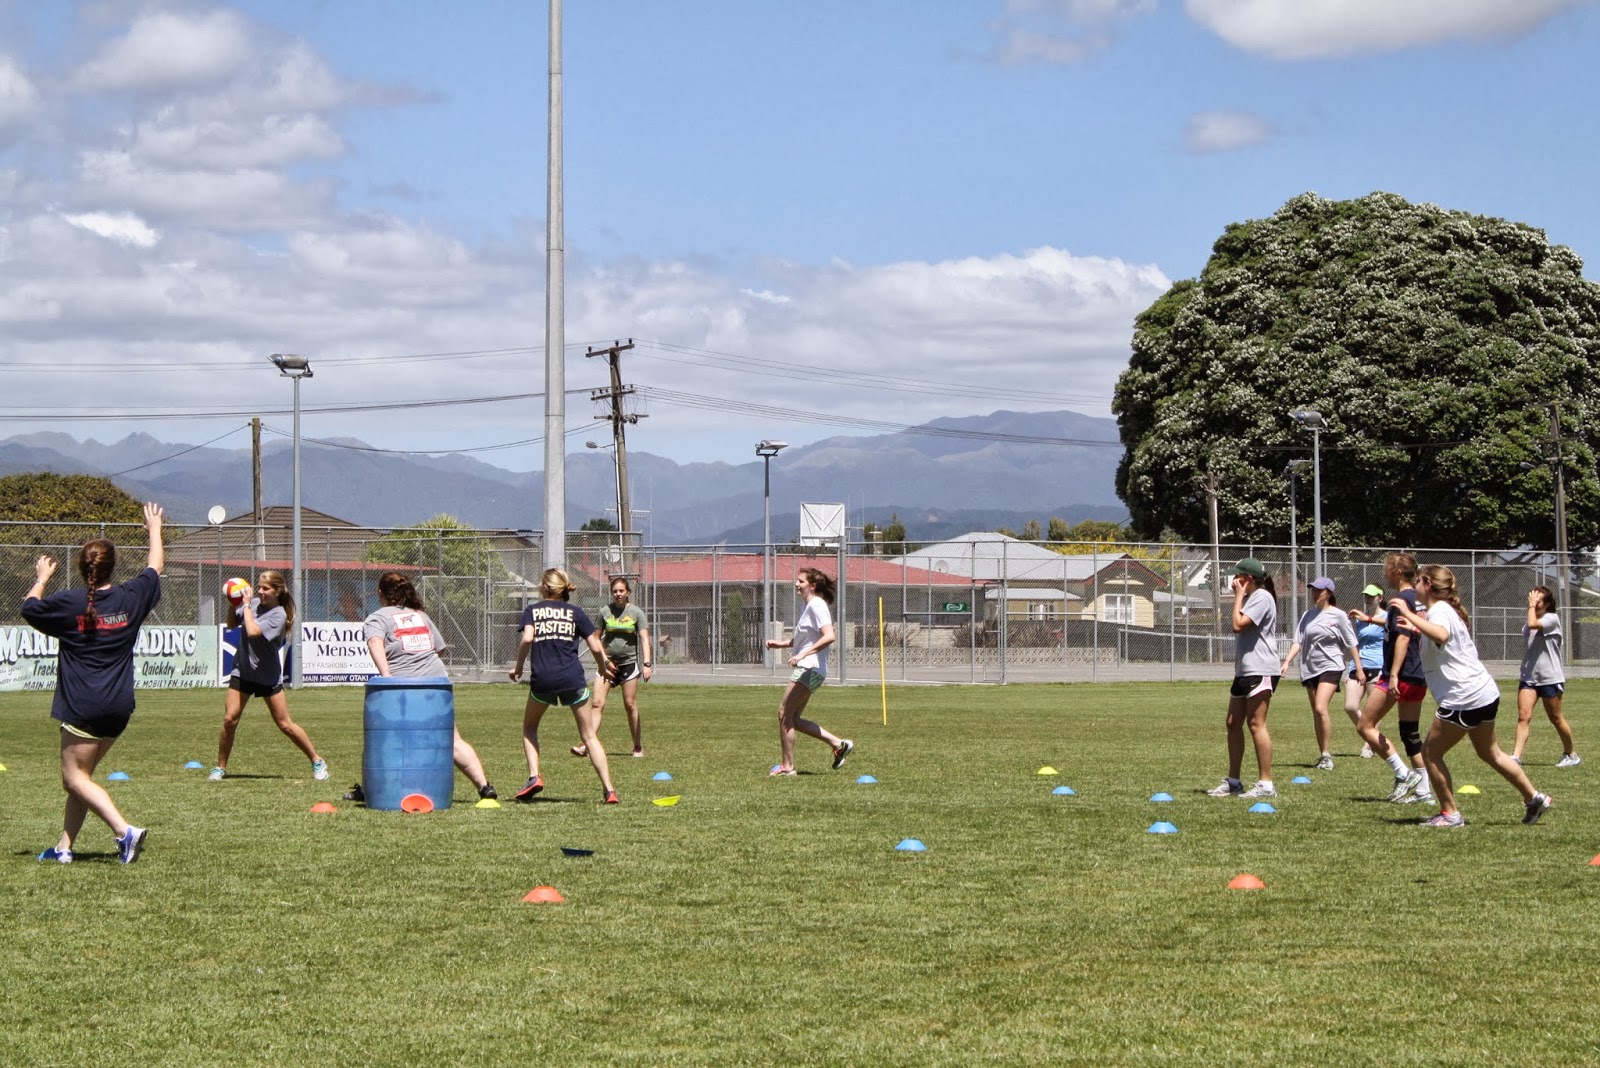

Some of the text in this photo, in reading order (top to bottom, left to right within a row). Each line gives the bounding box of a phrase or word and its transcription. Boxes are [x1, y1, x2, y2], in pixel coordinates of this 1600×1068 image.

[104, 613, 128, 625] SHOW
[532, 607, 573, 621] PADDLE
[302, 627, 366, 642] McAnd
[534, 621, 576, 636] FASTER!
[0, 627, 196, 661] MARL ADING
[317, 644, 369, 657] Mensw
[142, 661, 176, 678] Quickdry
[181, 661, 208, 676] Jackets
[24, 681, 44, 690] MAIN
